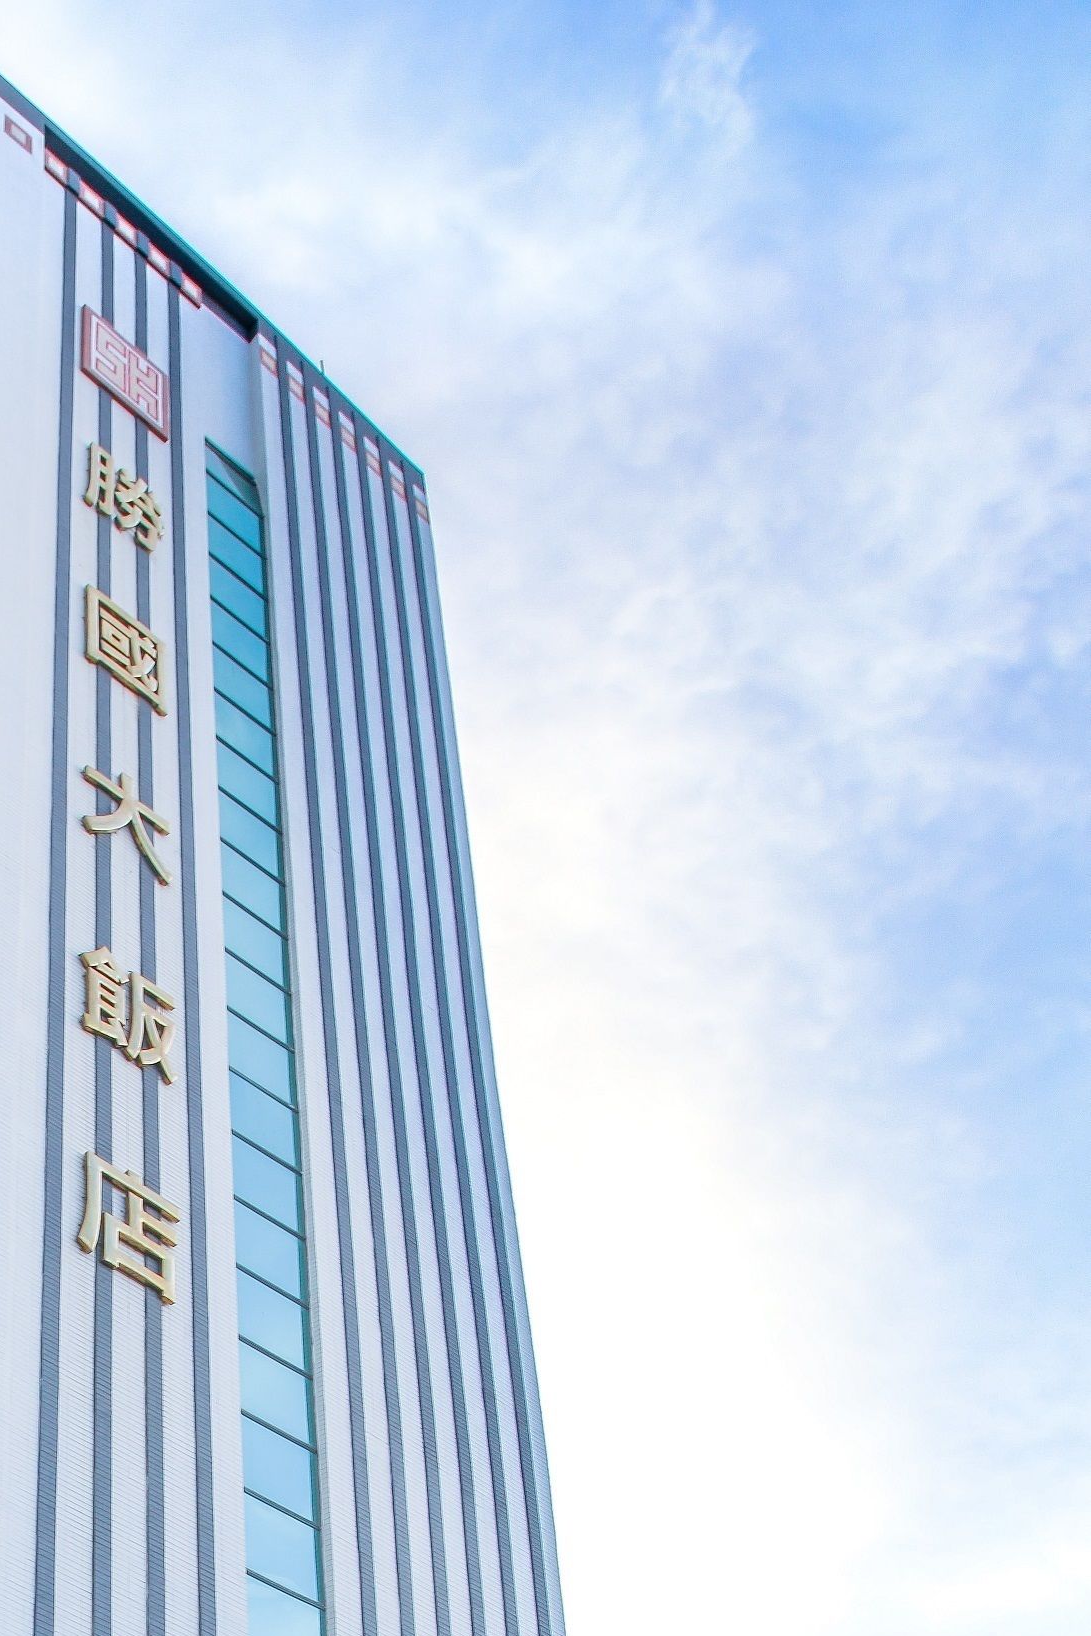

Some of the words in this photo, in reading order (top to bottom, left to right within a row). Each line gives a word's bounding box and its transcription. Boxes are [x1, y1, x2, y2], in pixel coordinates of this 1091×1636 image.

[76, 442, 180, 1304] 勝國大飯店
